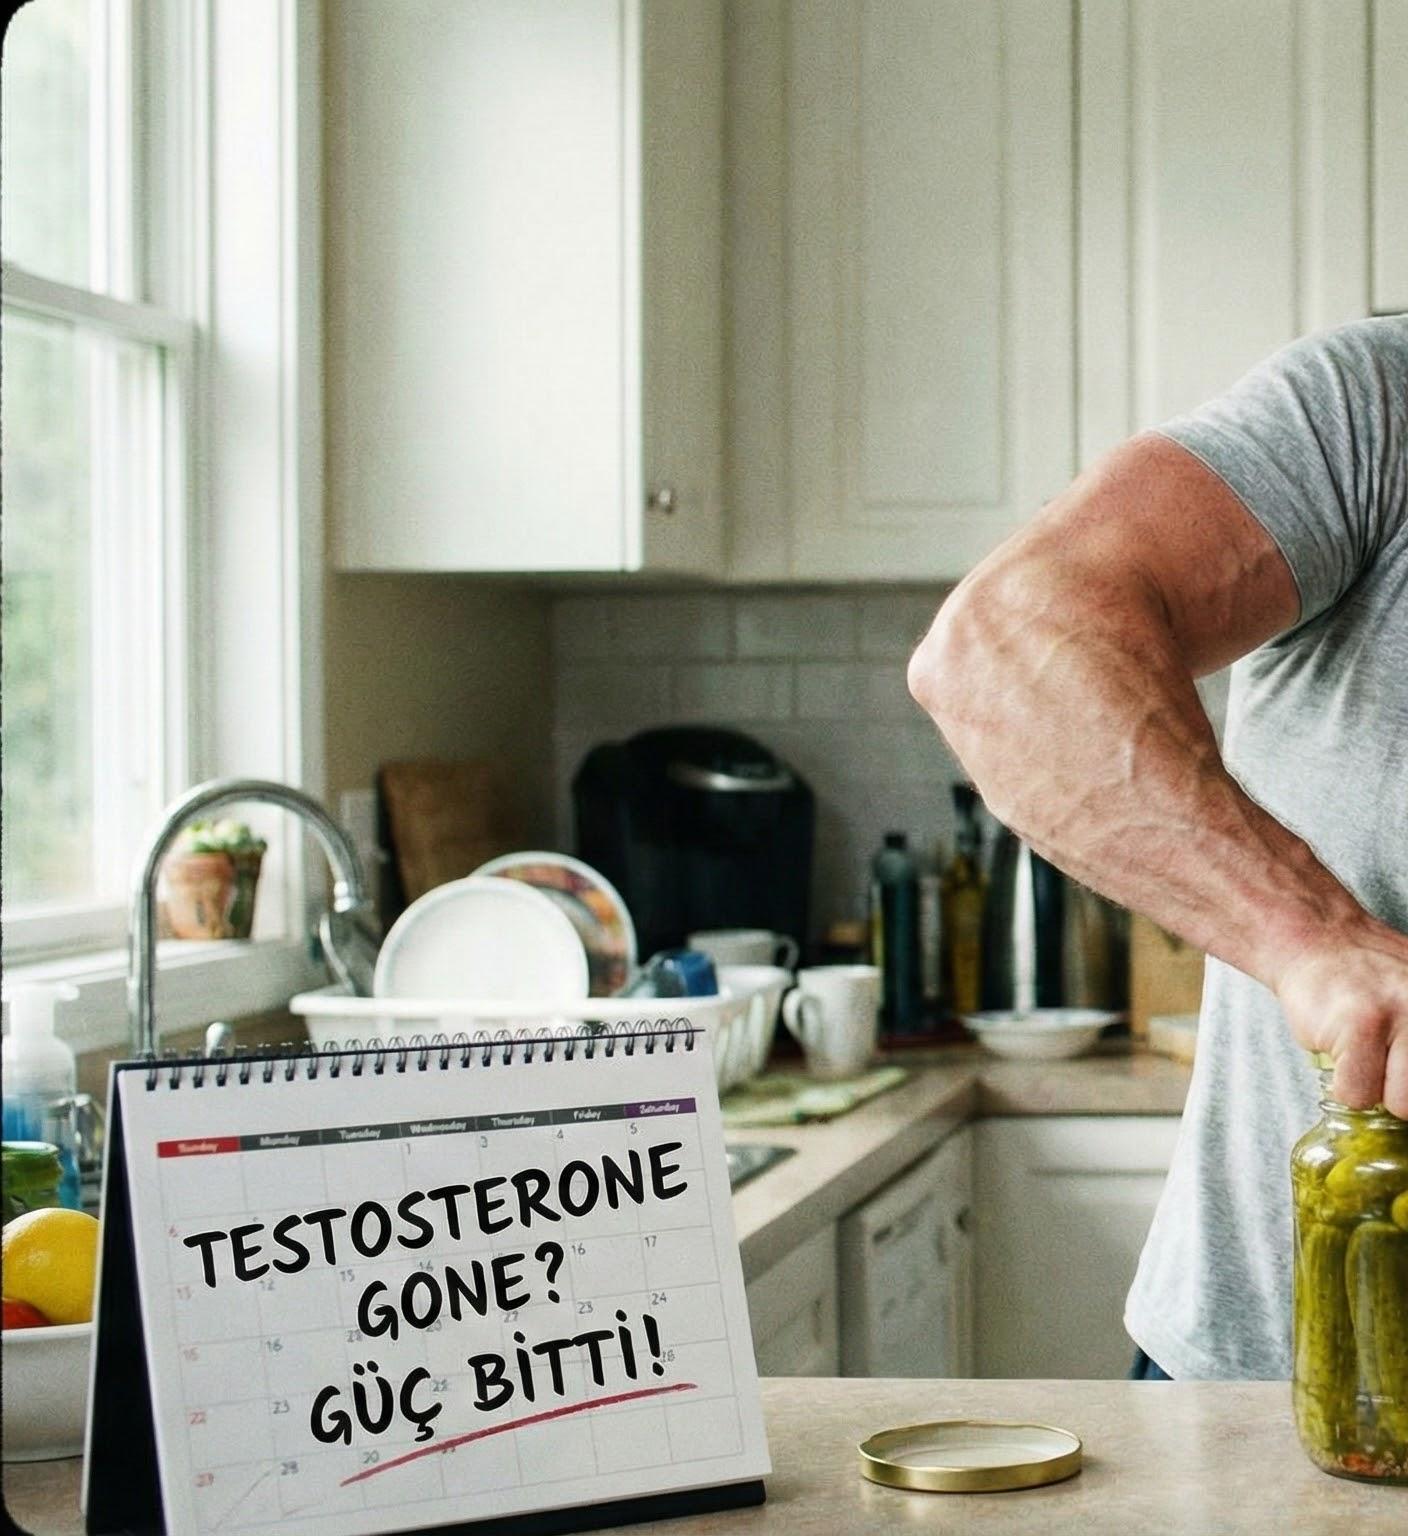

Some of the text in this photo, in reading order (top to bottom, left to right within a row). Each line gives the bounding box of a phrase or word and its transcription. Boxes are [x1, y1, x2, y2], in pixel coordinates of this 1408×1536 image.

[183, 1142, 688, 1288] TESTOSTERONE
[644, 1234, 657, 1248] 17
[357, 1241, 565, 1341] GONE?
[651, 1292, 667, 1306] 24
[310, 1309, 665, 1446] GÜÇ BİTTİ!
